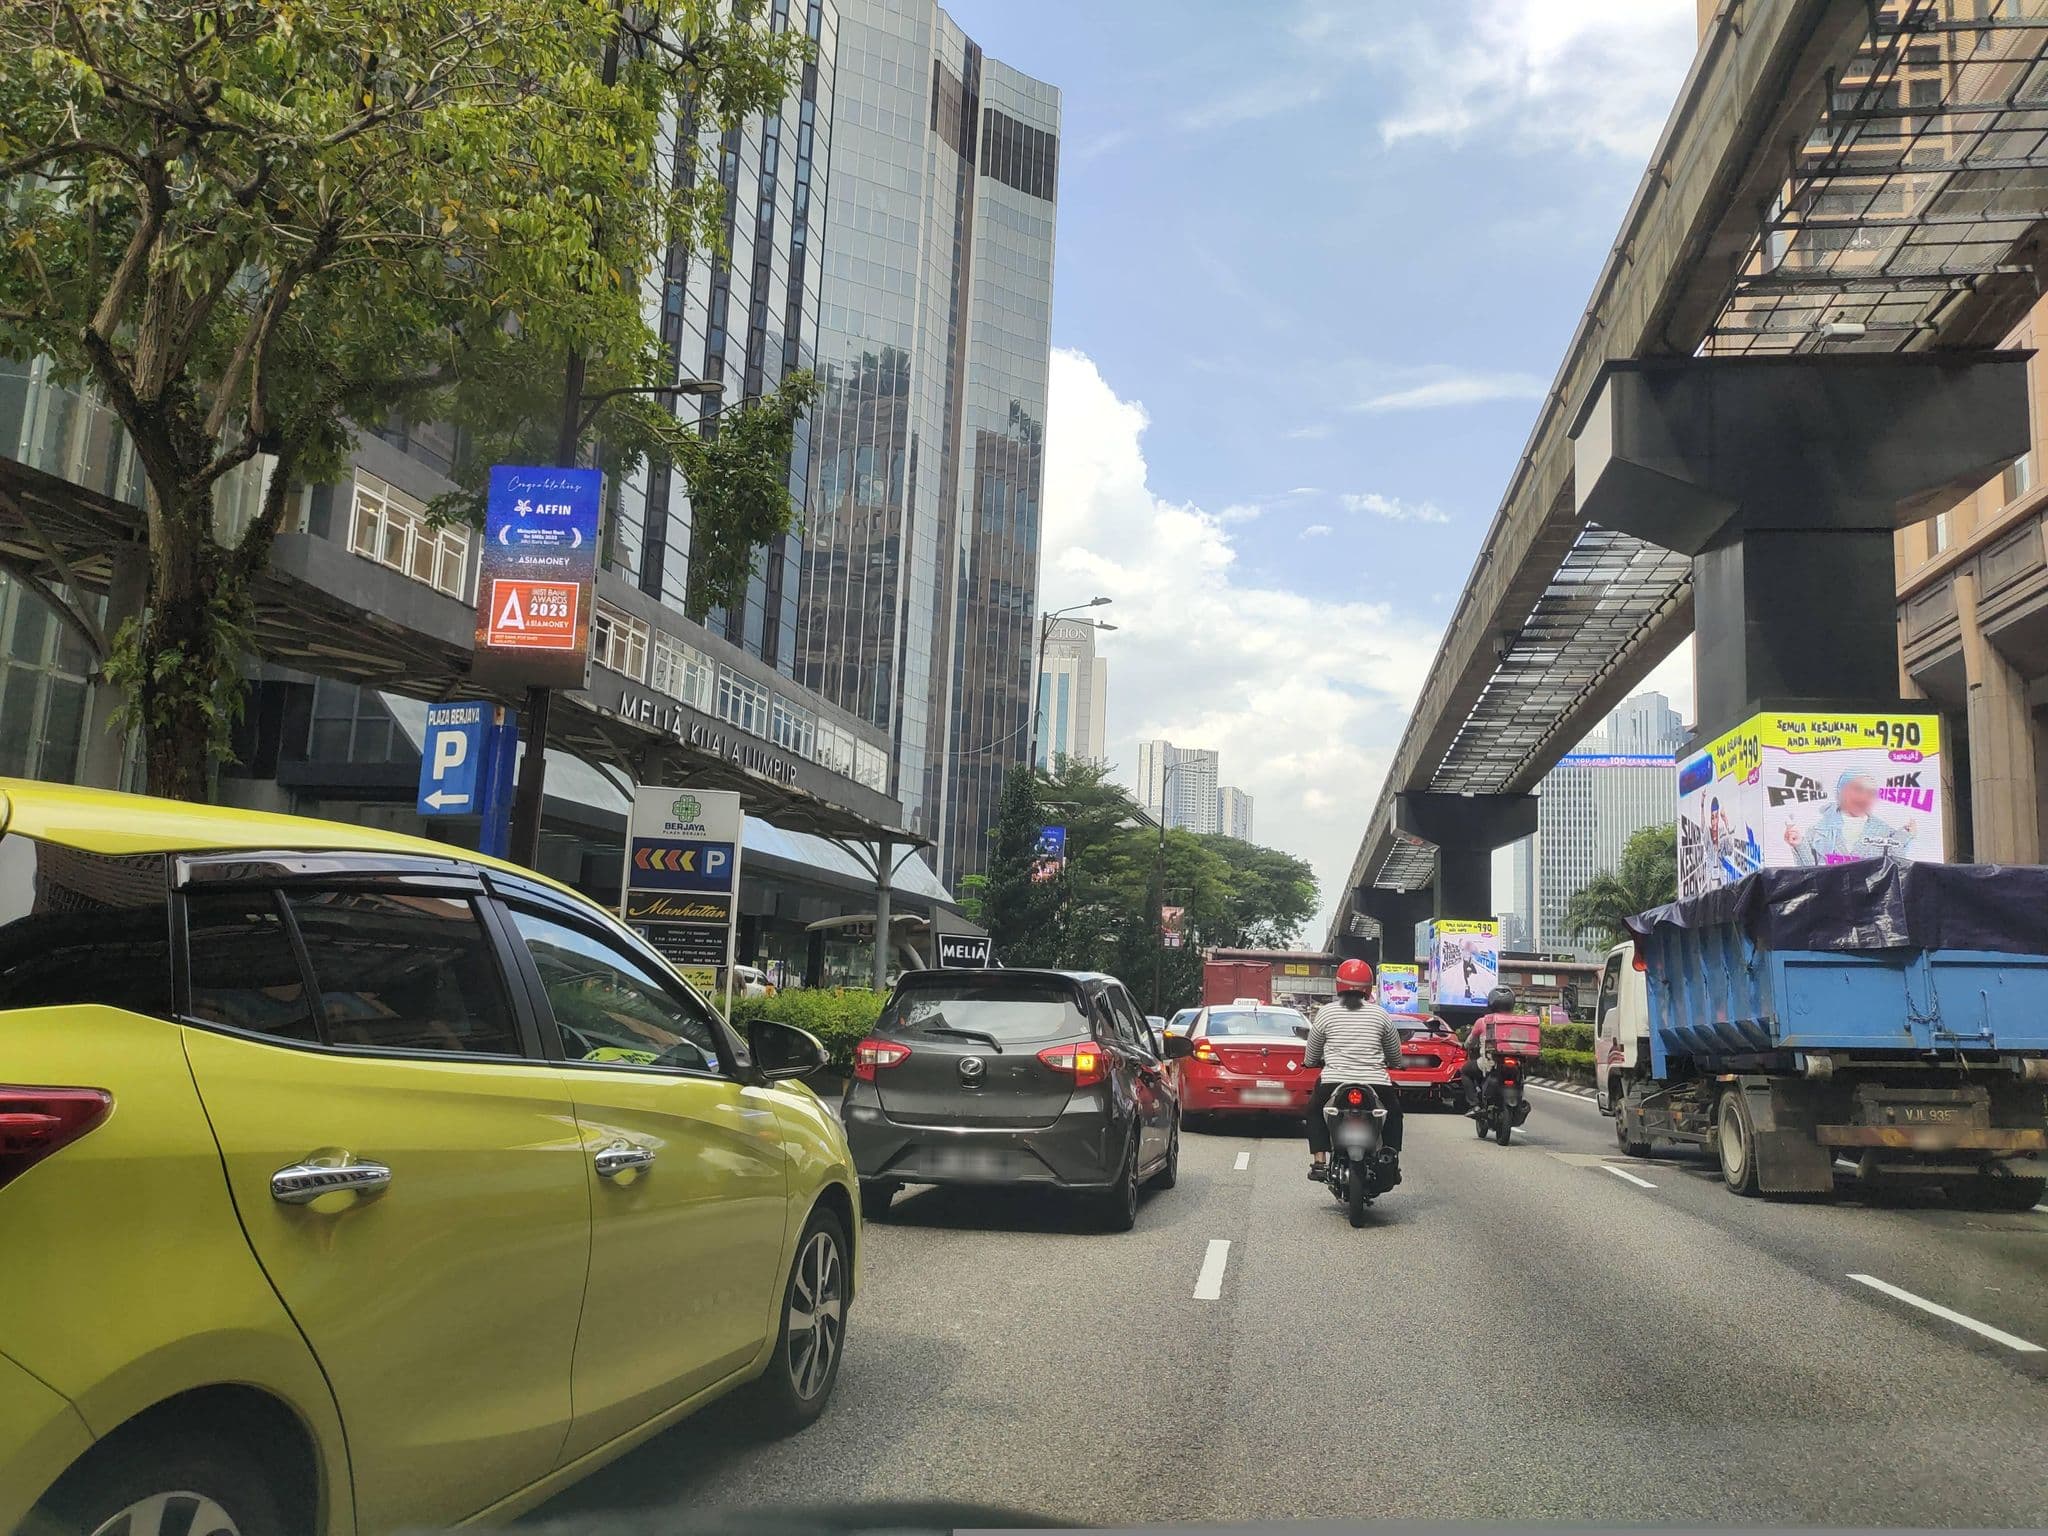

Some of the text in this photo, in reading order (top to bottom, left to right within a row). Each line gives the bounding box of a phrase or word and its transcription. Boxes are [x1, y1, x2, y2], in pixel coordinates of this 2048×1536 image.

[535, 503, 572, 516] AFFIN
[518, 556, 570, 566] ASIAMONEY
[496, 586, 525, 630] A
[530, 596, 568, 604] AWARDS
[529, 603, 568, 617] 2023
[525, 620, 569, 628] ASIAMONEY
[428, 707, 480, 726] PLAZA BERJAYA
[1776, 719, 1807, 733] SEMUA
[1811, 720, 1858, 734] KESUKAAN
[1876, 720, 1921, 749] 9.90
[1787, 735, 1842, 747] ANDA HANYA
[432, 731, 468, 780] P
[1609, 757, 1626, 765] 100
[1886, 770, 1922, 788] NAK
[1878, 787, 1934, 813] RISAU
[664, 821, 706, 833] BERJAYA
[706, 850, 726, 875] P
[629, 897, 727, 919] Manhattan
